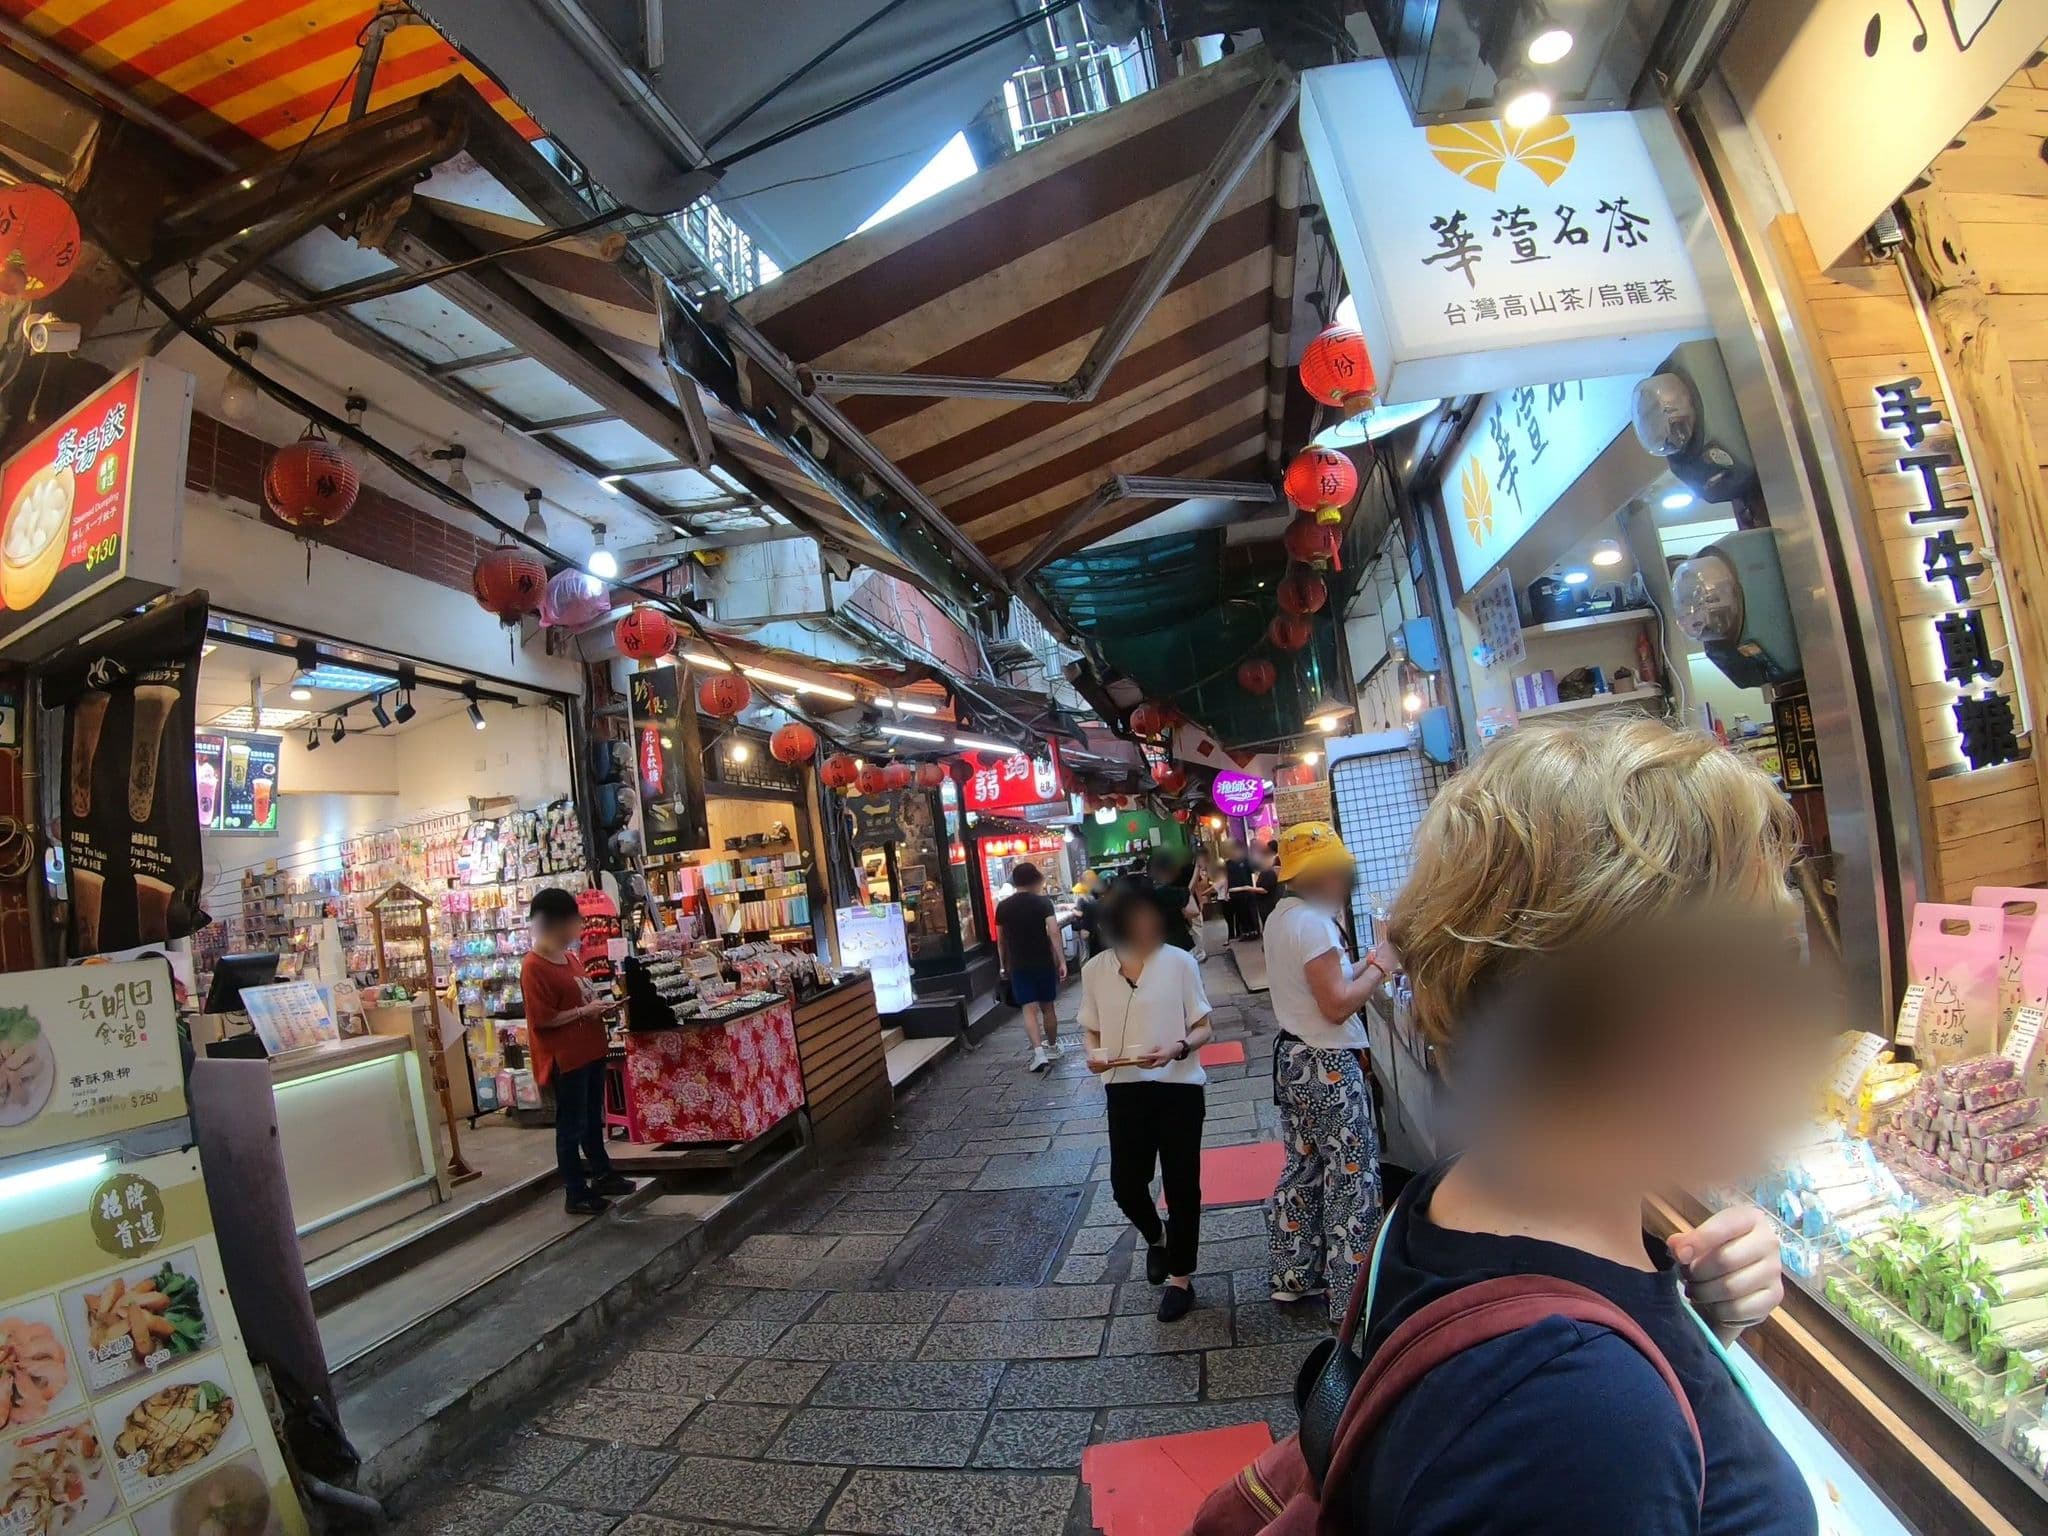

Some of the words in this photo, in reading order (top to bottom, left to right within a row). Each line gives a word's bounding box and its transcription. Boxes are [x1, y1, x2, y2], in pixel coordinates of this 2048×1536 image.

[1421, 196, 1650, 288] 華萱名茶
[1443, 278, 1678, 326] 台灣高山茶/烏龍茶
[86, 533, 117, 571] $130
[1231, 803, 1250, 814] 101
[95, 1022, 138, 1049] 食堂
[1928, 1029, 1966, 1047] 雪花餅
[114, 1211, 162, 1249] 首選
